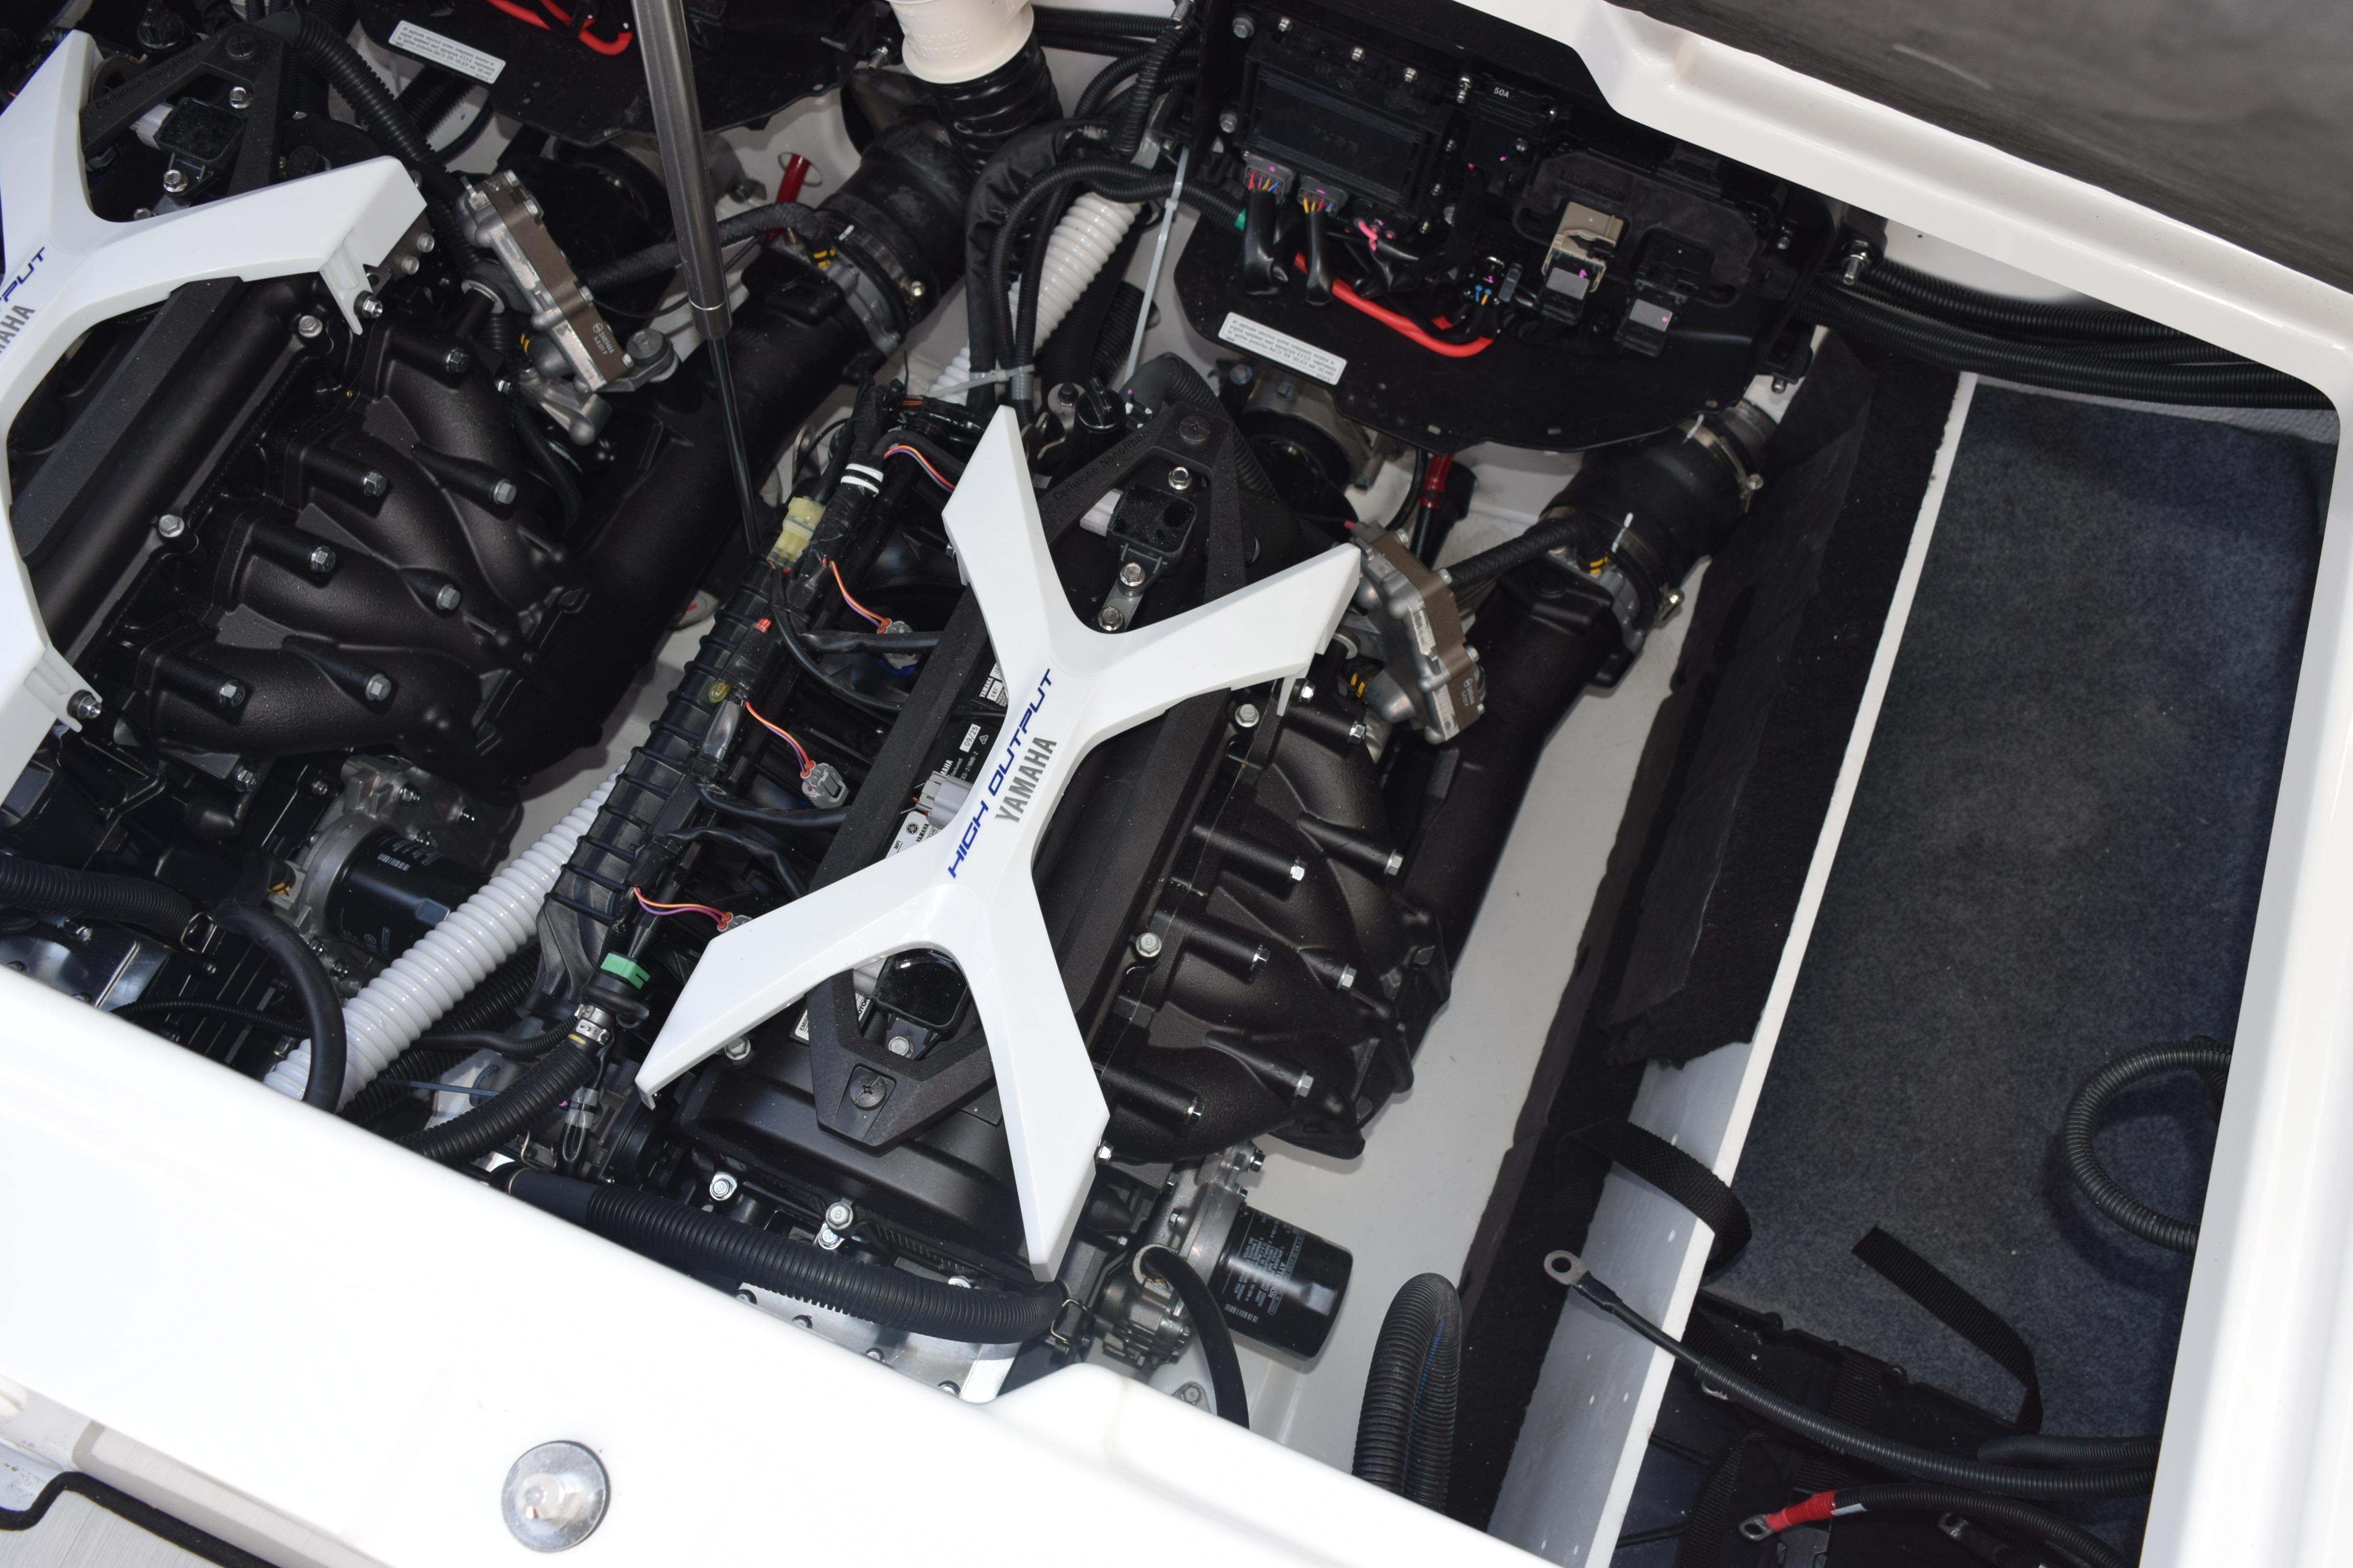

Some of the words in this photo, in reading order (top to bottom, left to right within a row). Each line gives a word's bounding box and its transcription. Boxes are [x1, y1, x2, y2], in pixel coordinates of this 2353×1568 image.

[1493, 86, 1510, 98] 50A
[0, 246, 45, 303] PUT
[978, 676, 994, 699] YAMAHA
[962, 725, 980, 747] 09/25
[939, 758, 954, 776] MAHA
[948, 800, 989, 878] HIGH
[988, 668, 1051, 796] OUTPUT
[995, 737, 1058, 823] YAMAHA
[914, 822, 931, 843] YAMAHA
[893, 839, 902, 850] MFI
[1267, 1261, 1286, 1299] ATTETION
